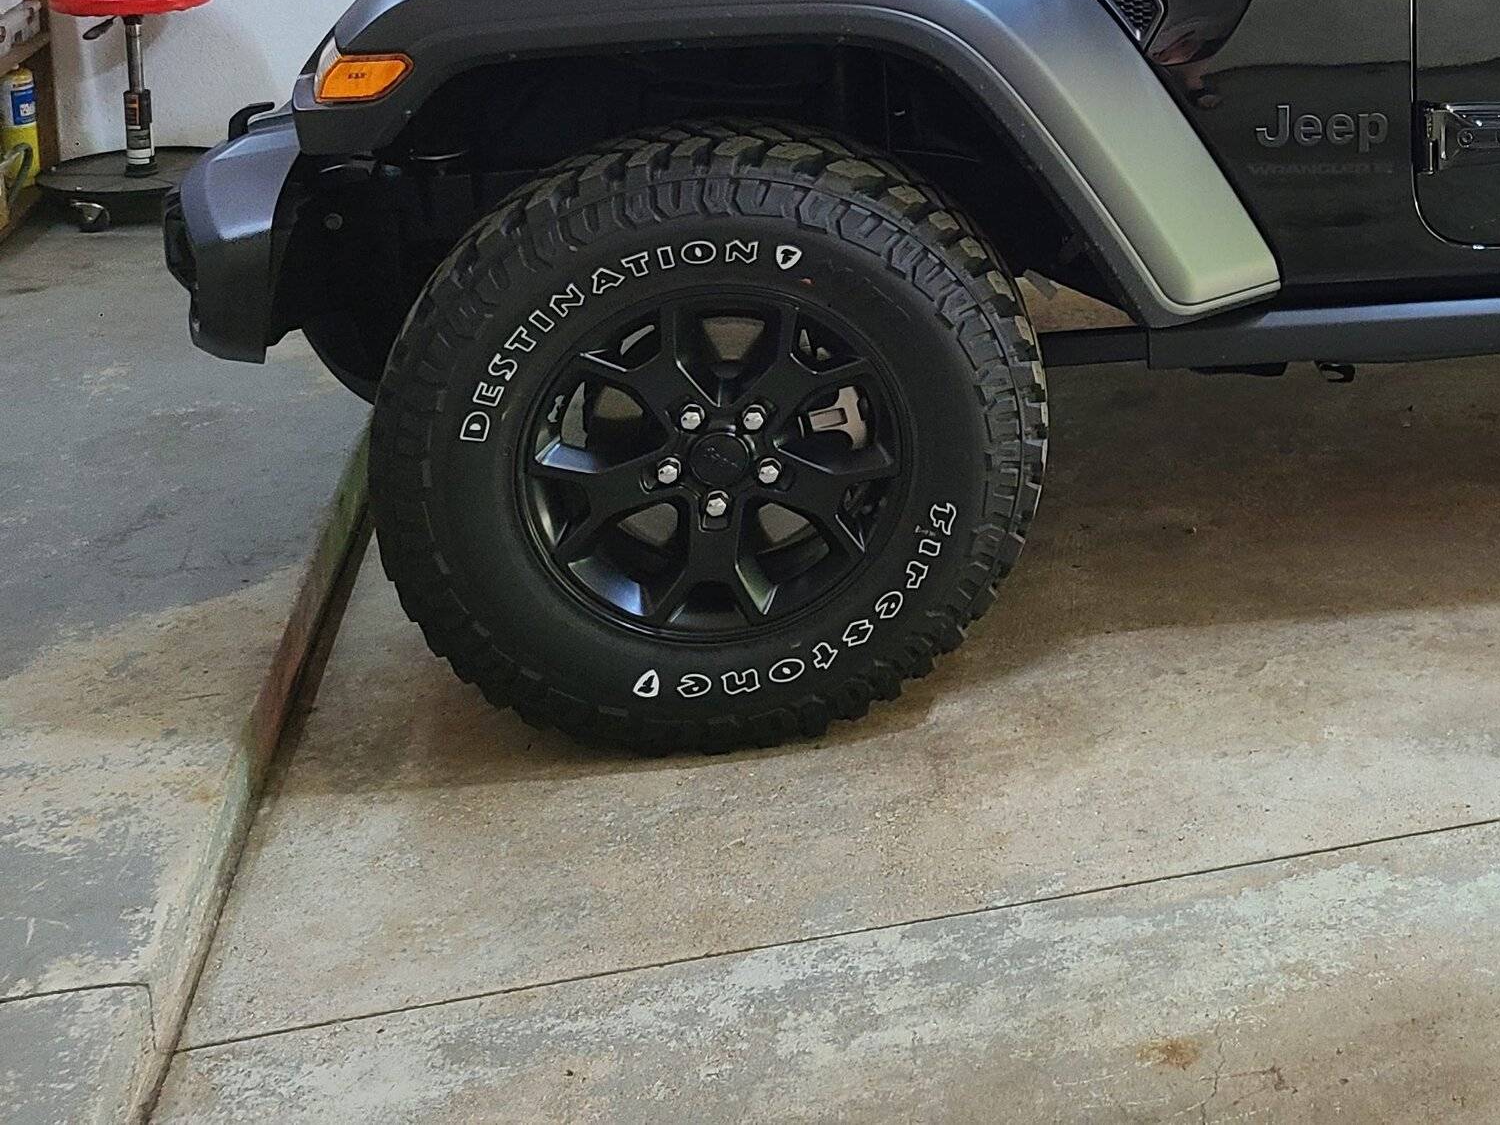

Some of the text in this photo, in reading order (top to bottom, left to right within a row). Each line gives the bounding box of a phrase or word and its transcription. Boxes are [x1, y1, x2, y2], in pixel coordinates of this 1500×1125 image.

[1255, 104, 1390, 154] Jeep
[460, 240, 760, 443] DESTINATION
[677, 502, 958, 698] Firestone
